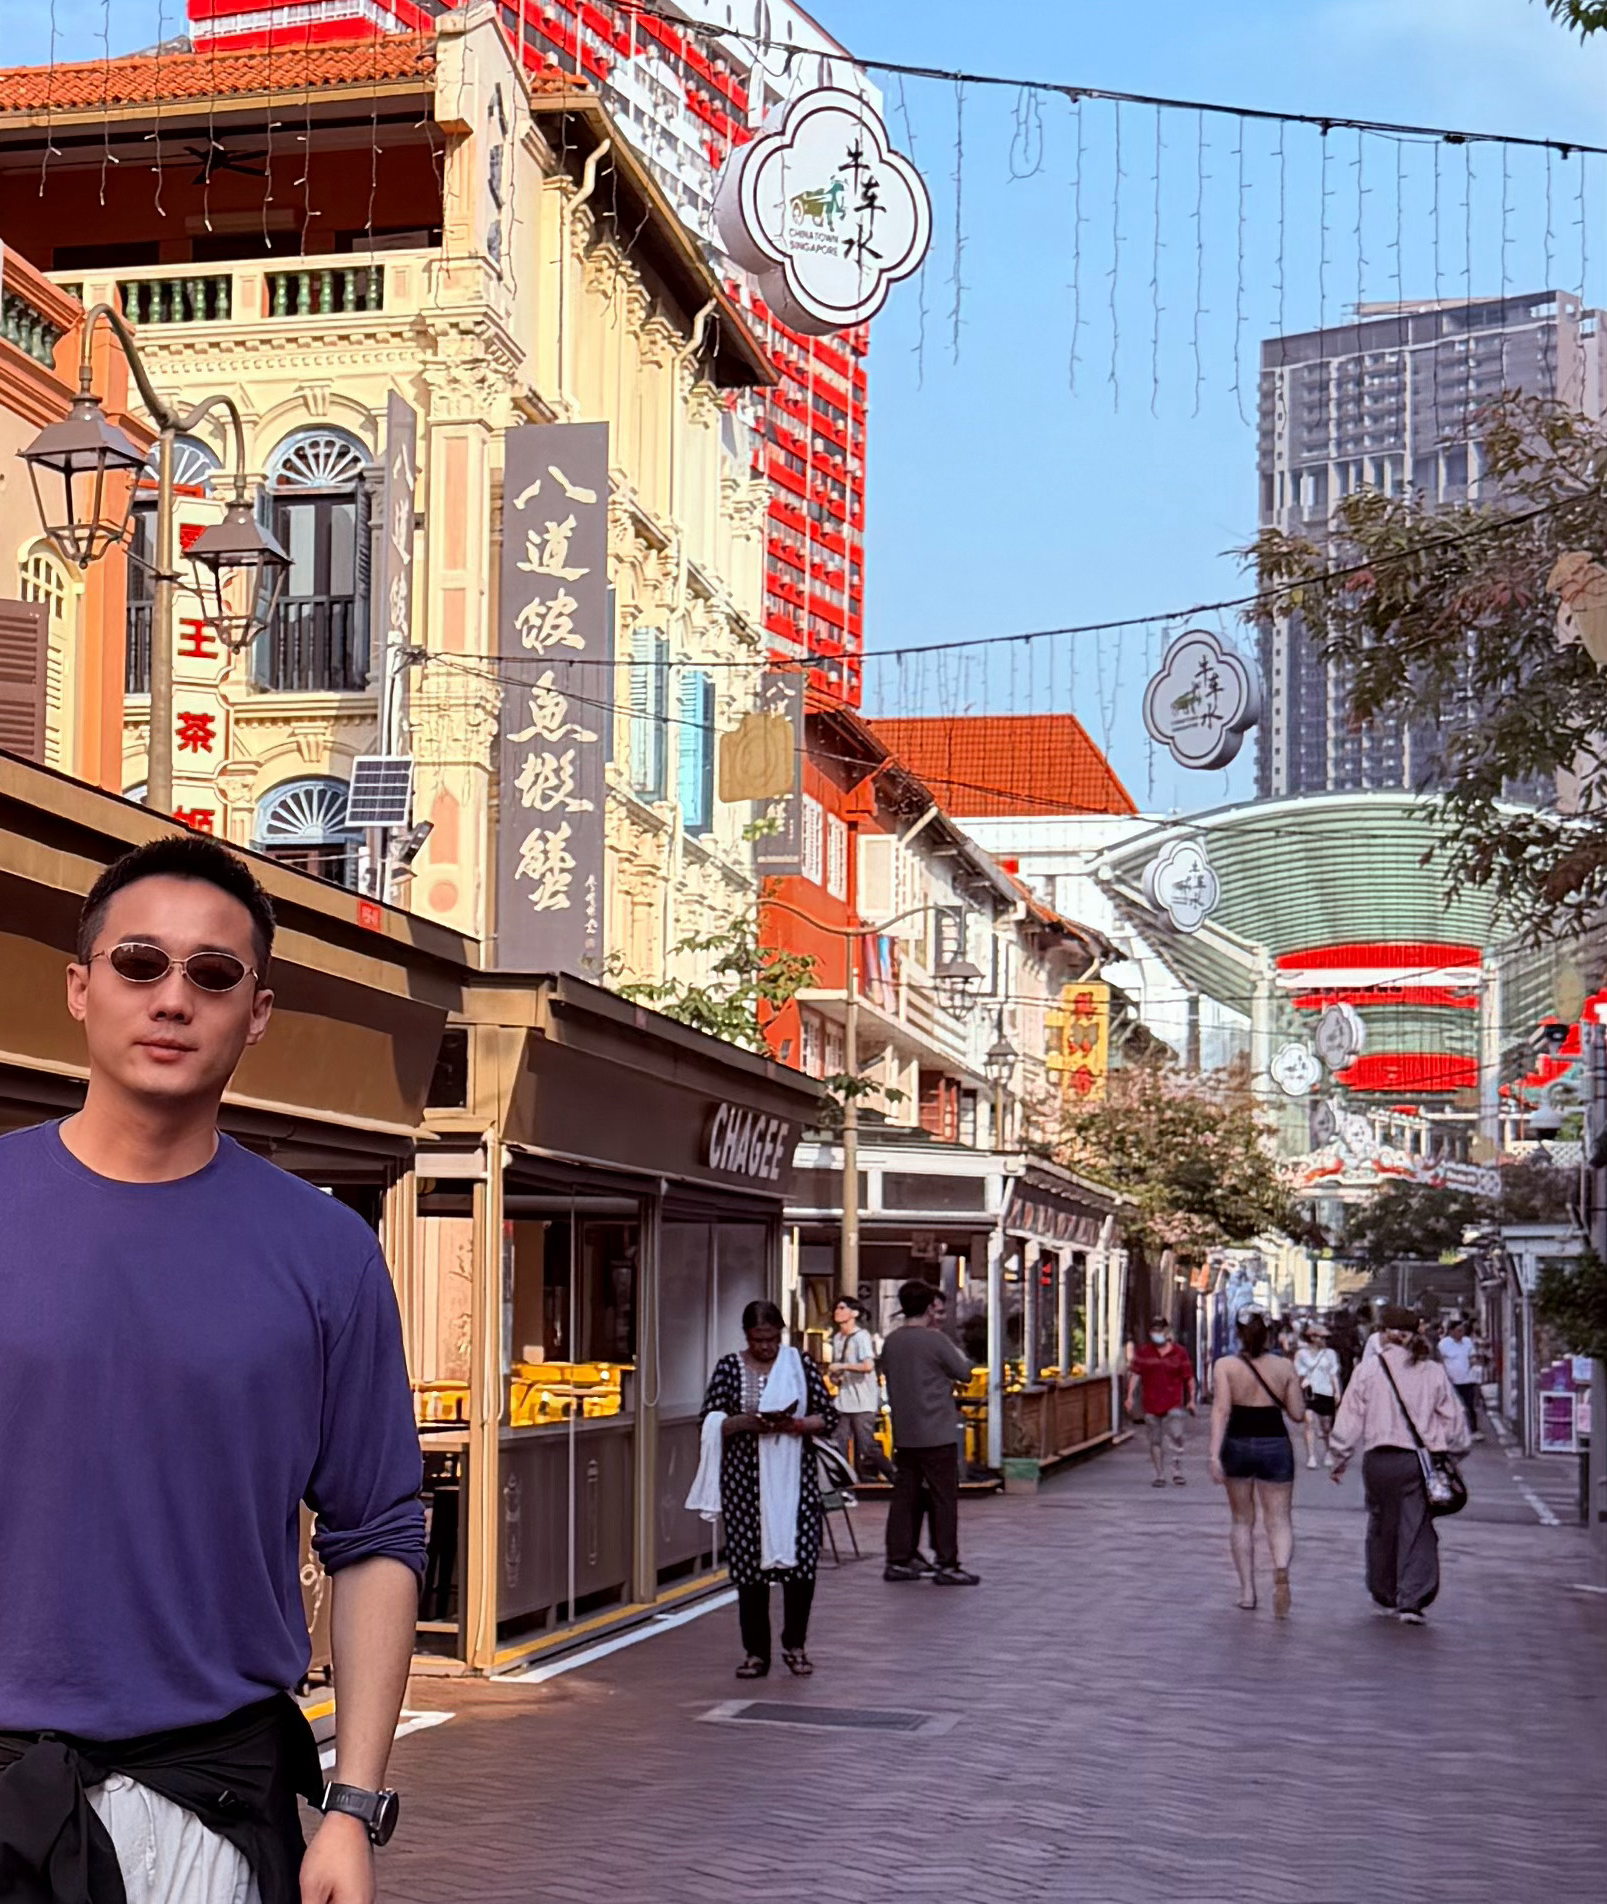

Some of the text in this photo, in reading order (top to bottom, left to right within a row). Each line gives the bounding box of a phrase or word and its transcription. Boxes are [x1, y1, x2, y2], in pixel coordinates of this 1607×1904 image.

[789, 227, 839, 244] CHINATOWN
[789, 239, 839, 257] SINGAPORE
[709, 1102, 790, 1180] CHAGEE
